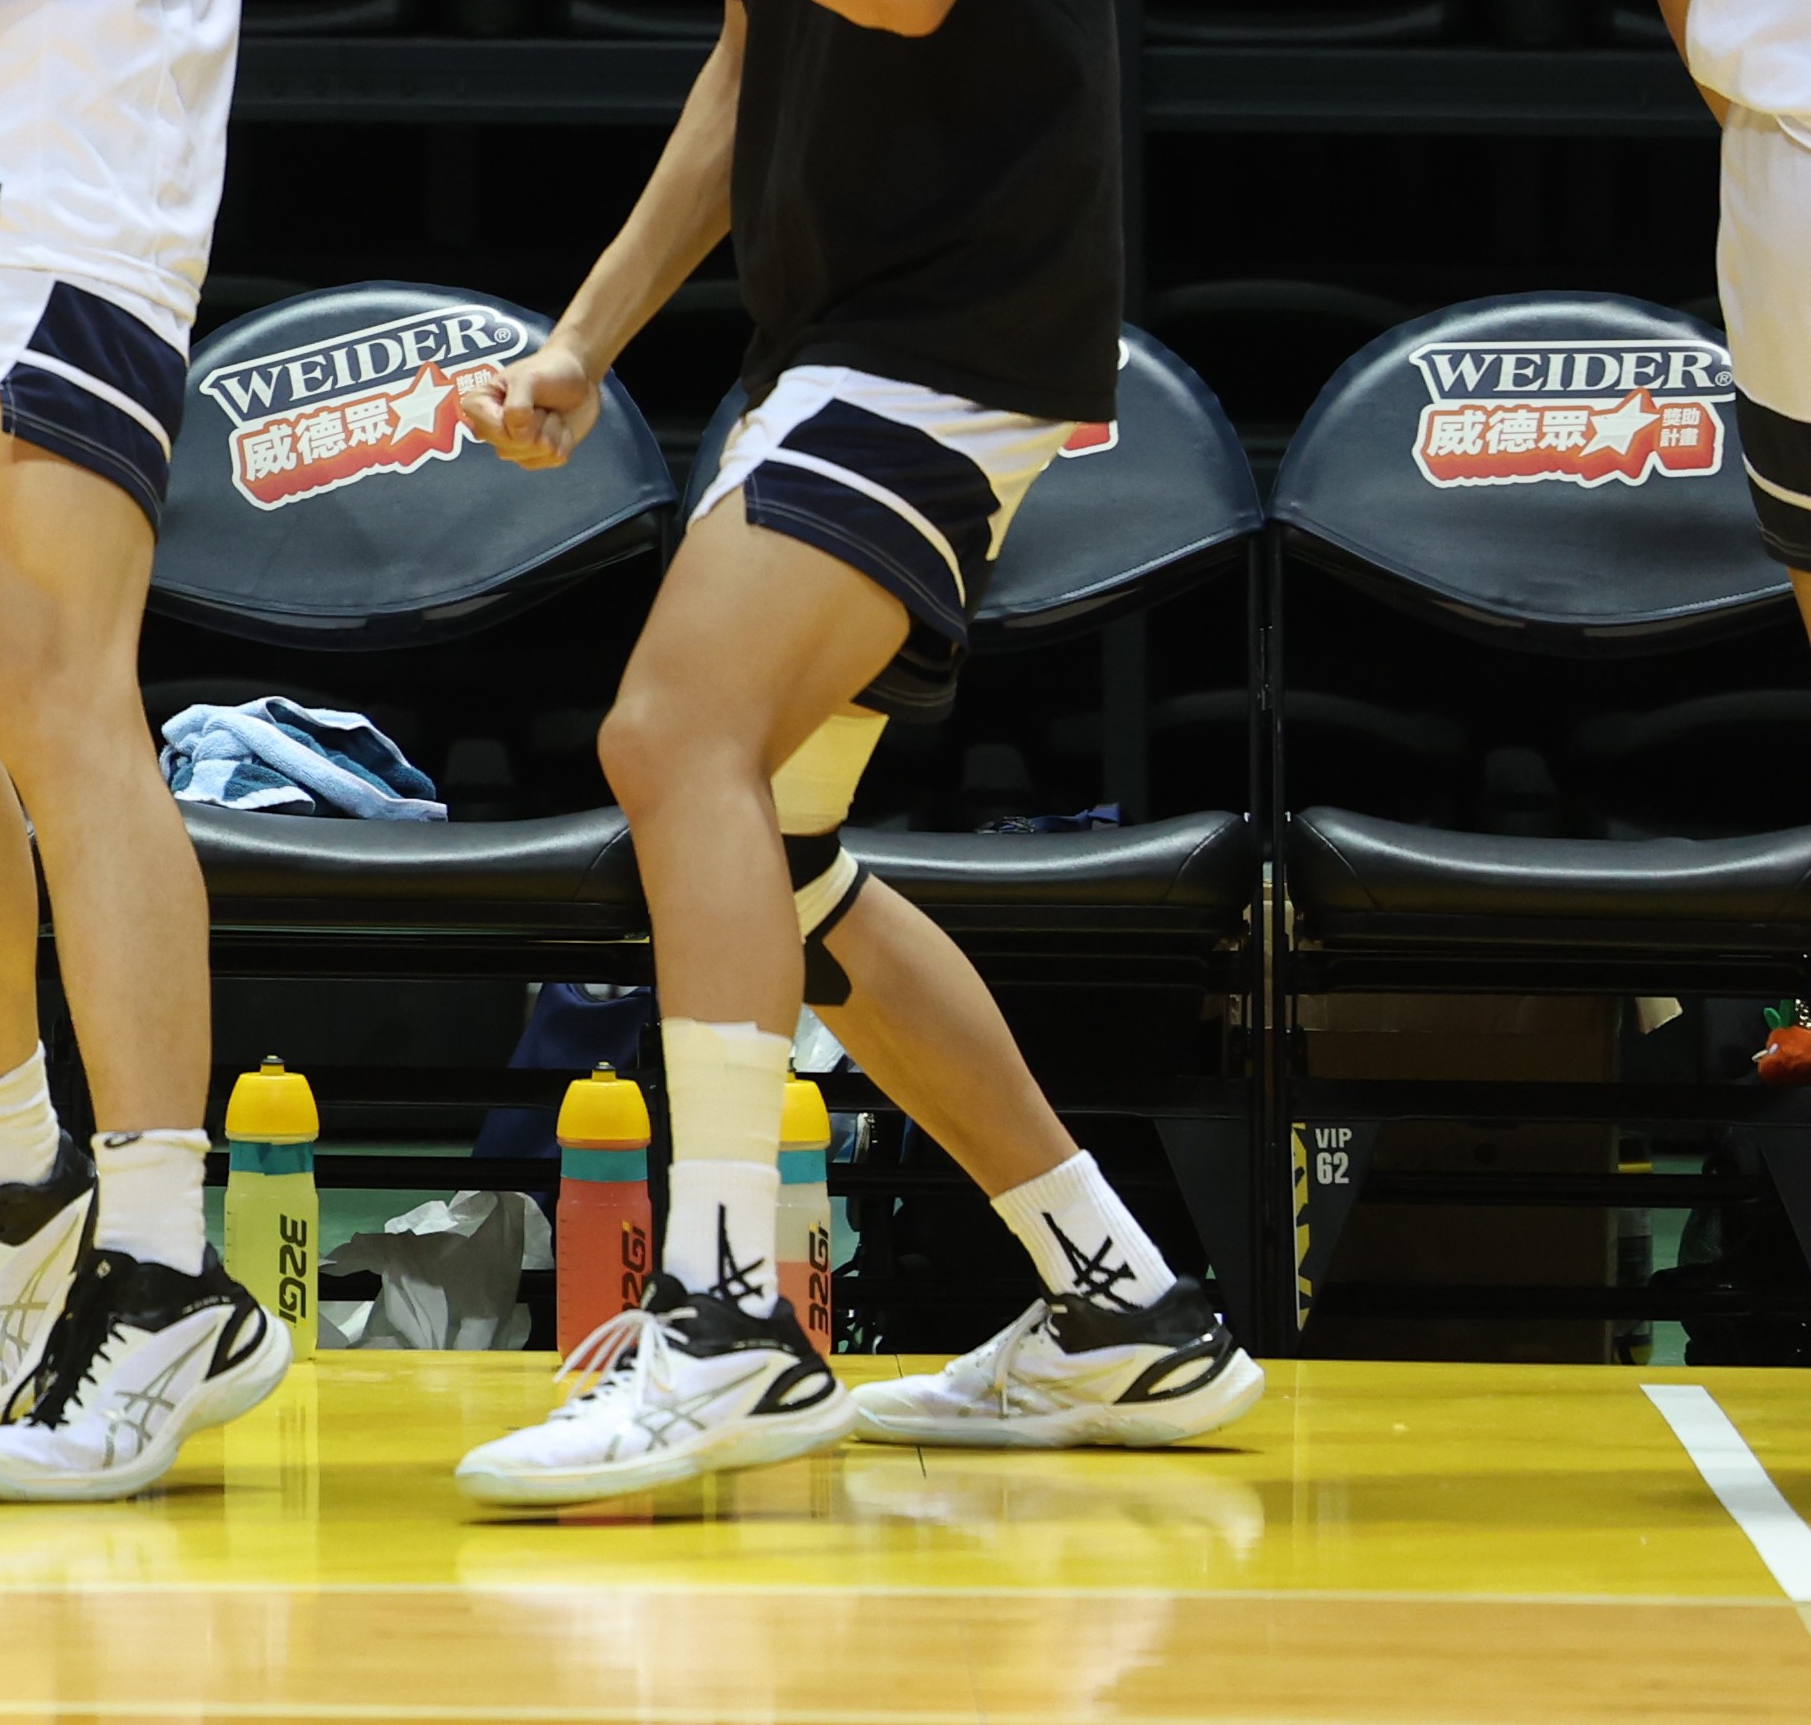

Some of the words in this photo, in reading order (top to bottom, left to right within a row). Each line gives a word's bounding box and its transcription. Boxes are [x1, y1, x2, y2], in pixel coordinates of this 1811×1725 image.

[243, 396, 396, 482] 威德眾
[1426, 410, 1592, 457] 威德眾
[1314, 1127, 1353, 1149] VIP
[1315, 1151, 1351, 1186] 62
